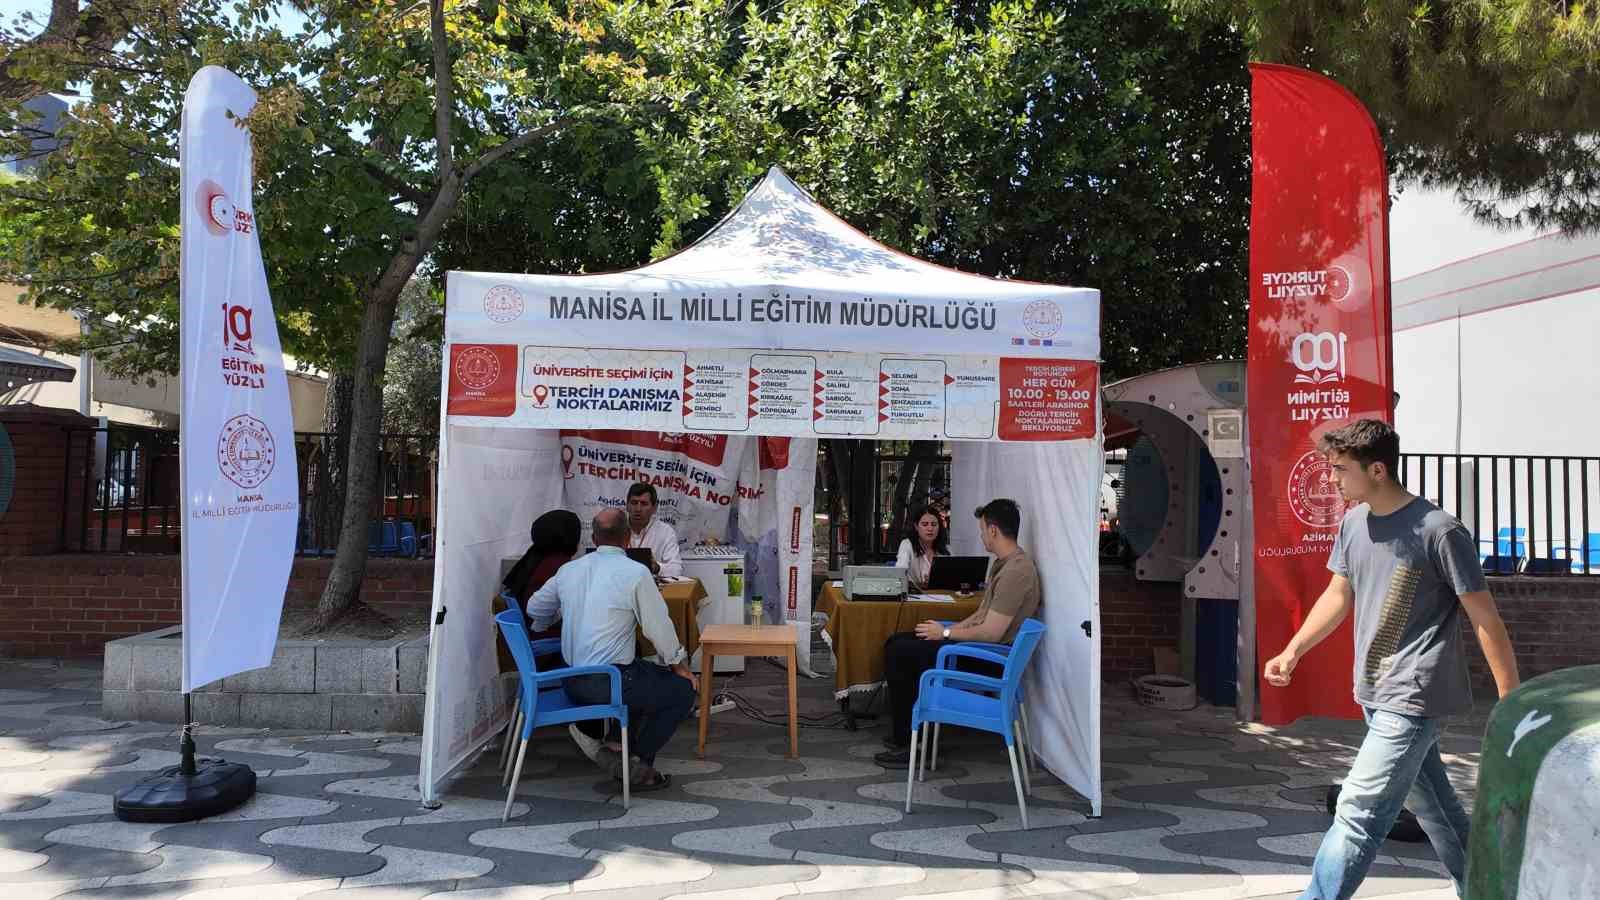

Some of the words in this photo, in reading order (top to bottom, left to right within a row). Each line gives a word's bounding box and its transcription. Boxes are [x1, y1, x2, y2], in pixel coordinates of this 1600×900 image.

[549, 291, 646, 321] MANİSA
[652, 292, 673, 321] İL
[681, 292, 742, 321] MİLLİ
[751, 293, 831, 325] EĞİTİM
[840, 297, 996, 331] MÜDÜRLÜĞÜ
[533, 364, 604, 378] ÜNİVERSİTE
[606, 367, 648, 381] SEÇİMİ
[649, 368, 673, 381] İÇİN
[1023, 378, 1047, 387] HER
[1050, 378, 1076, 388] GÜN
[549, 384, 604, 398] TERCİH
[608, 387, 680, 401] DANIŞMA
[1007, 388, 1044, 399] 10.00
[1055, 390, 1091, 400] 19.00
[556, 398, 673, 412] NOKTALARIMIZ
[577, 462, 636, 481] TERCİH
[689, 468, 717, 487] İÇİN
